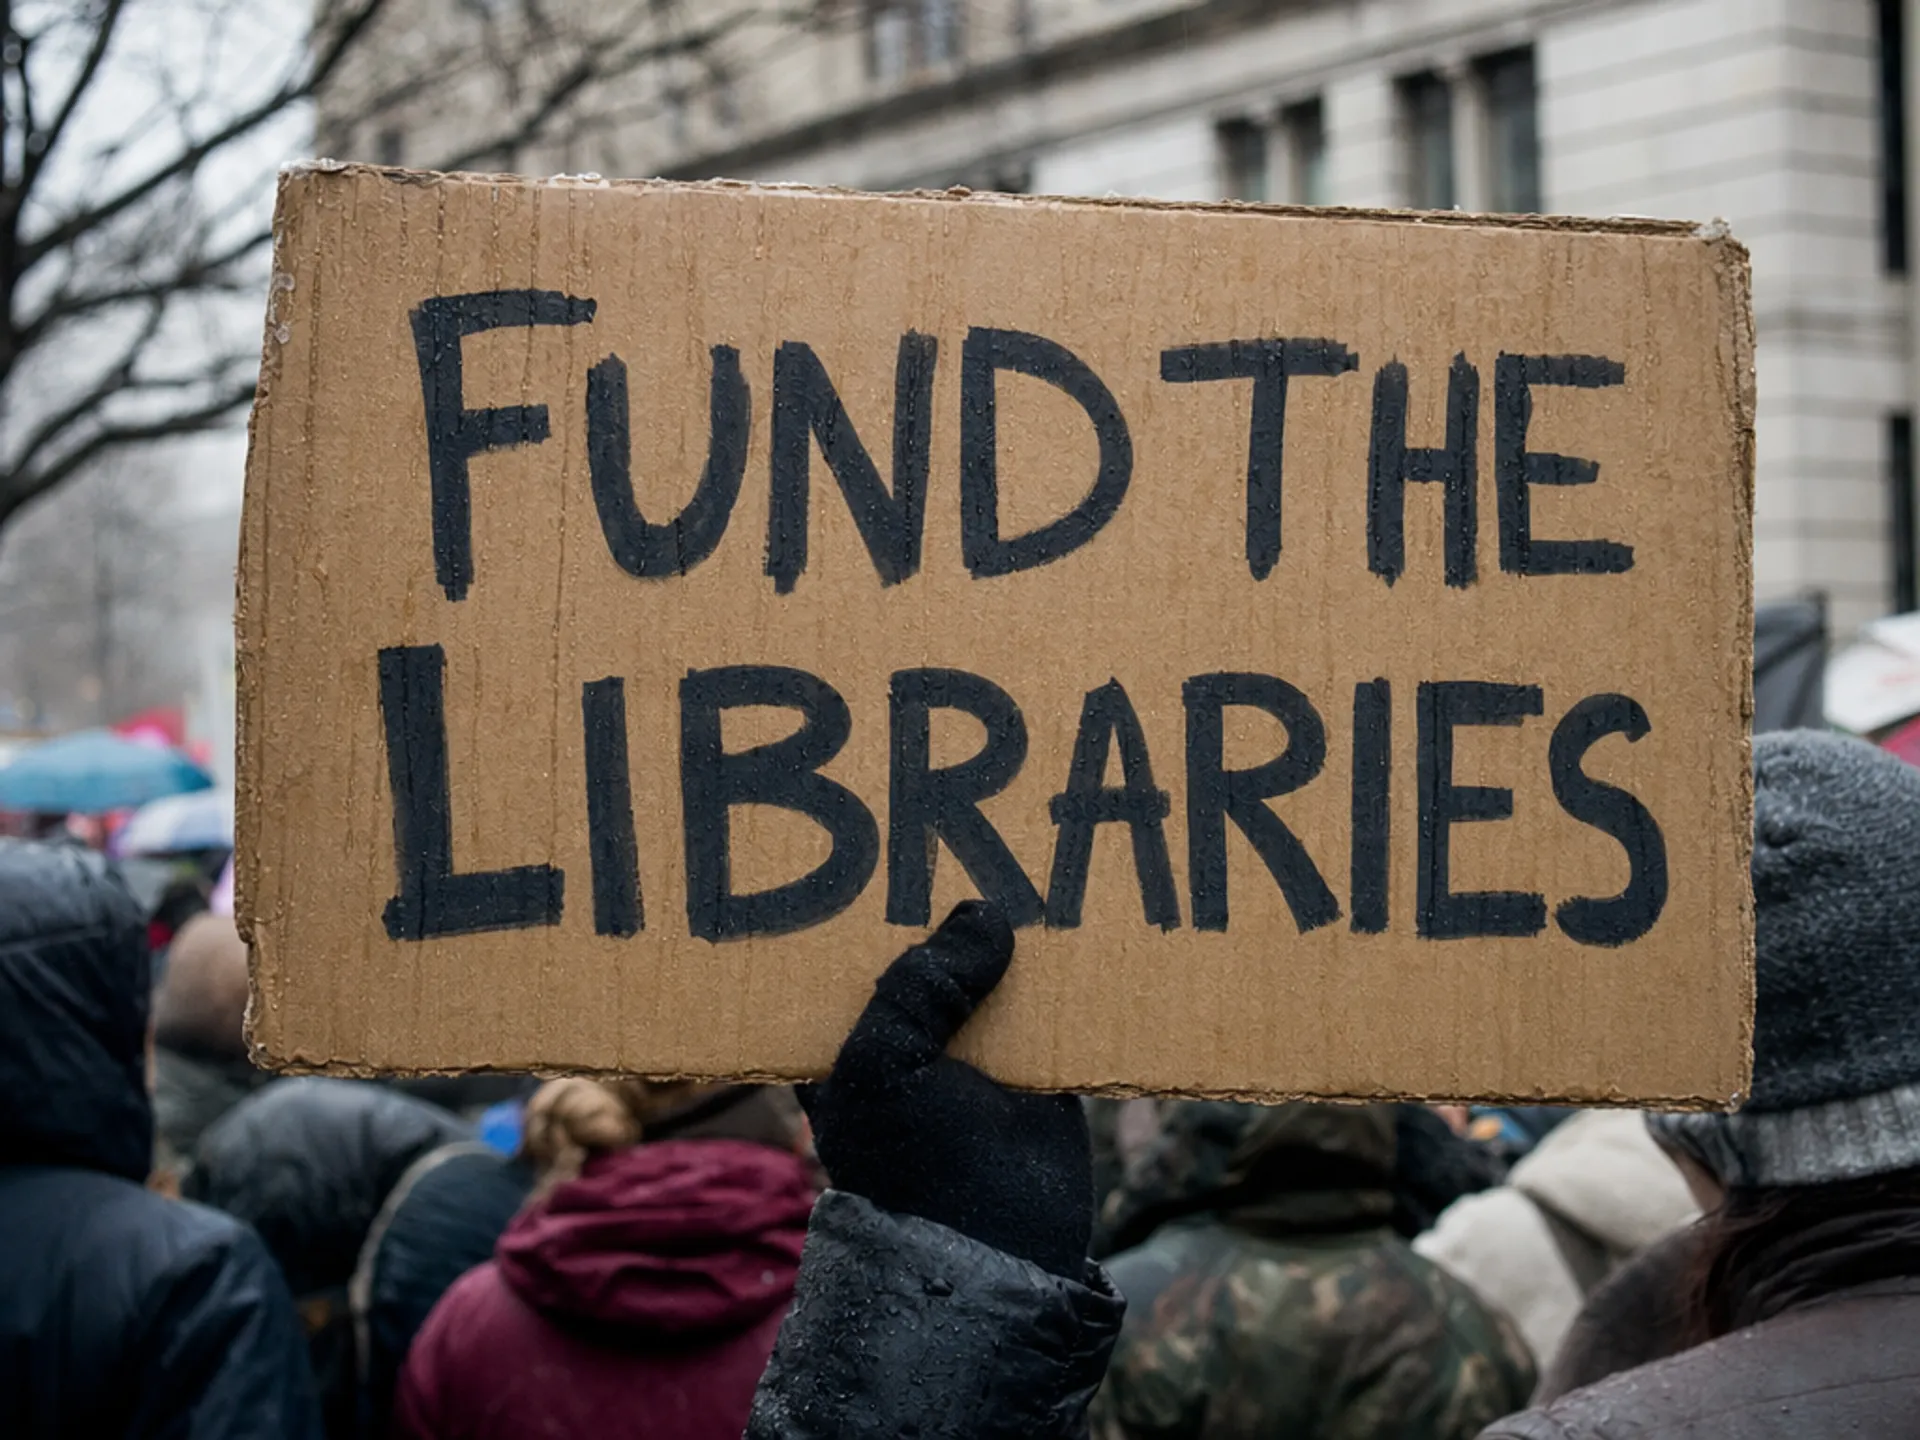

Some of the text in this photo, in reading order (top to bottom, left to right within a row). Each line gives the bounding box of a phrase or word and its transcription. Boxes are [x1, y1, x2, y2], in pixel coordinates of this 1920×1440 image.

[409, 287, 1635, 602] FUND THE
[377, 643, 1669, 948] LIBRARIES
